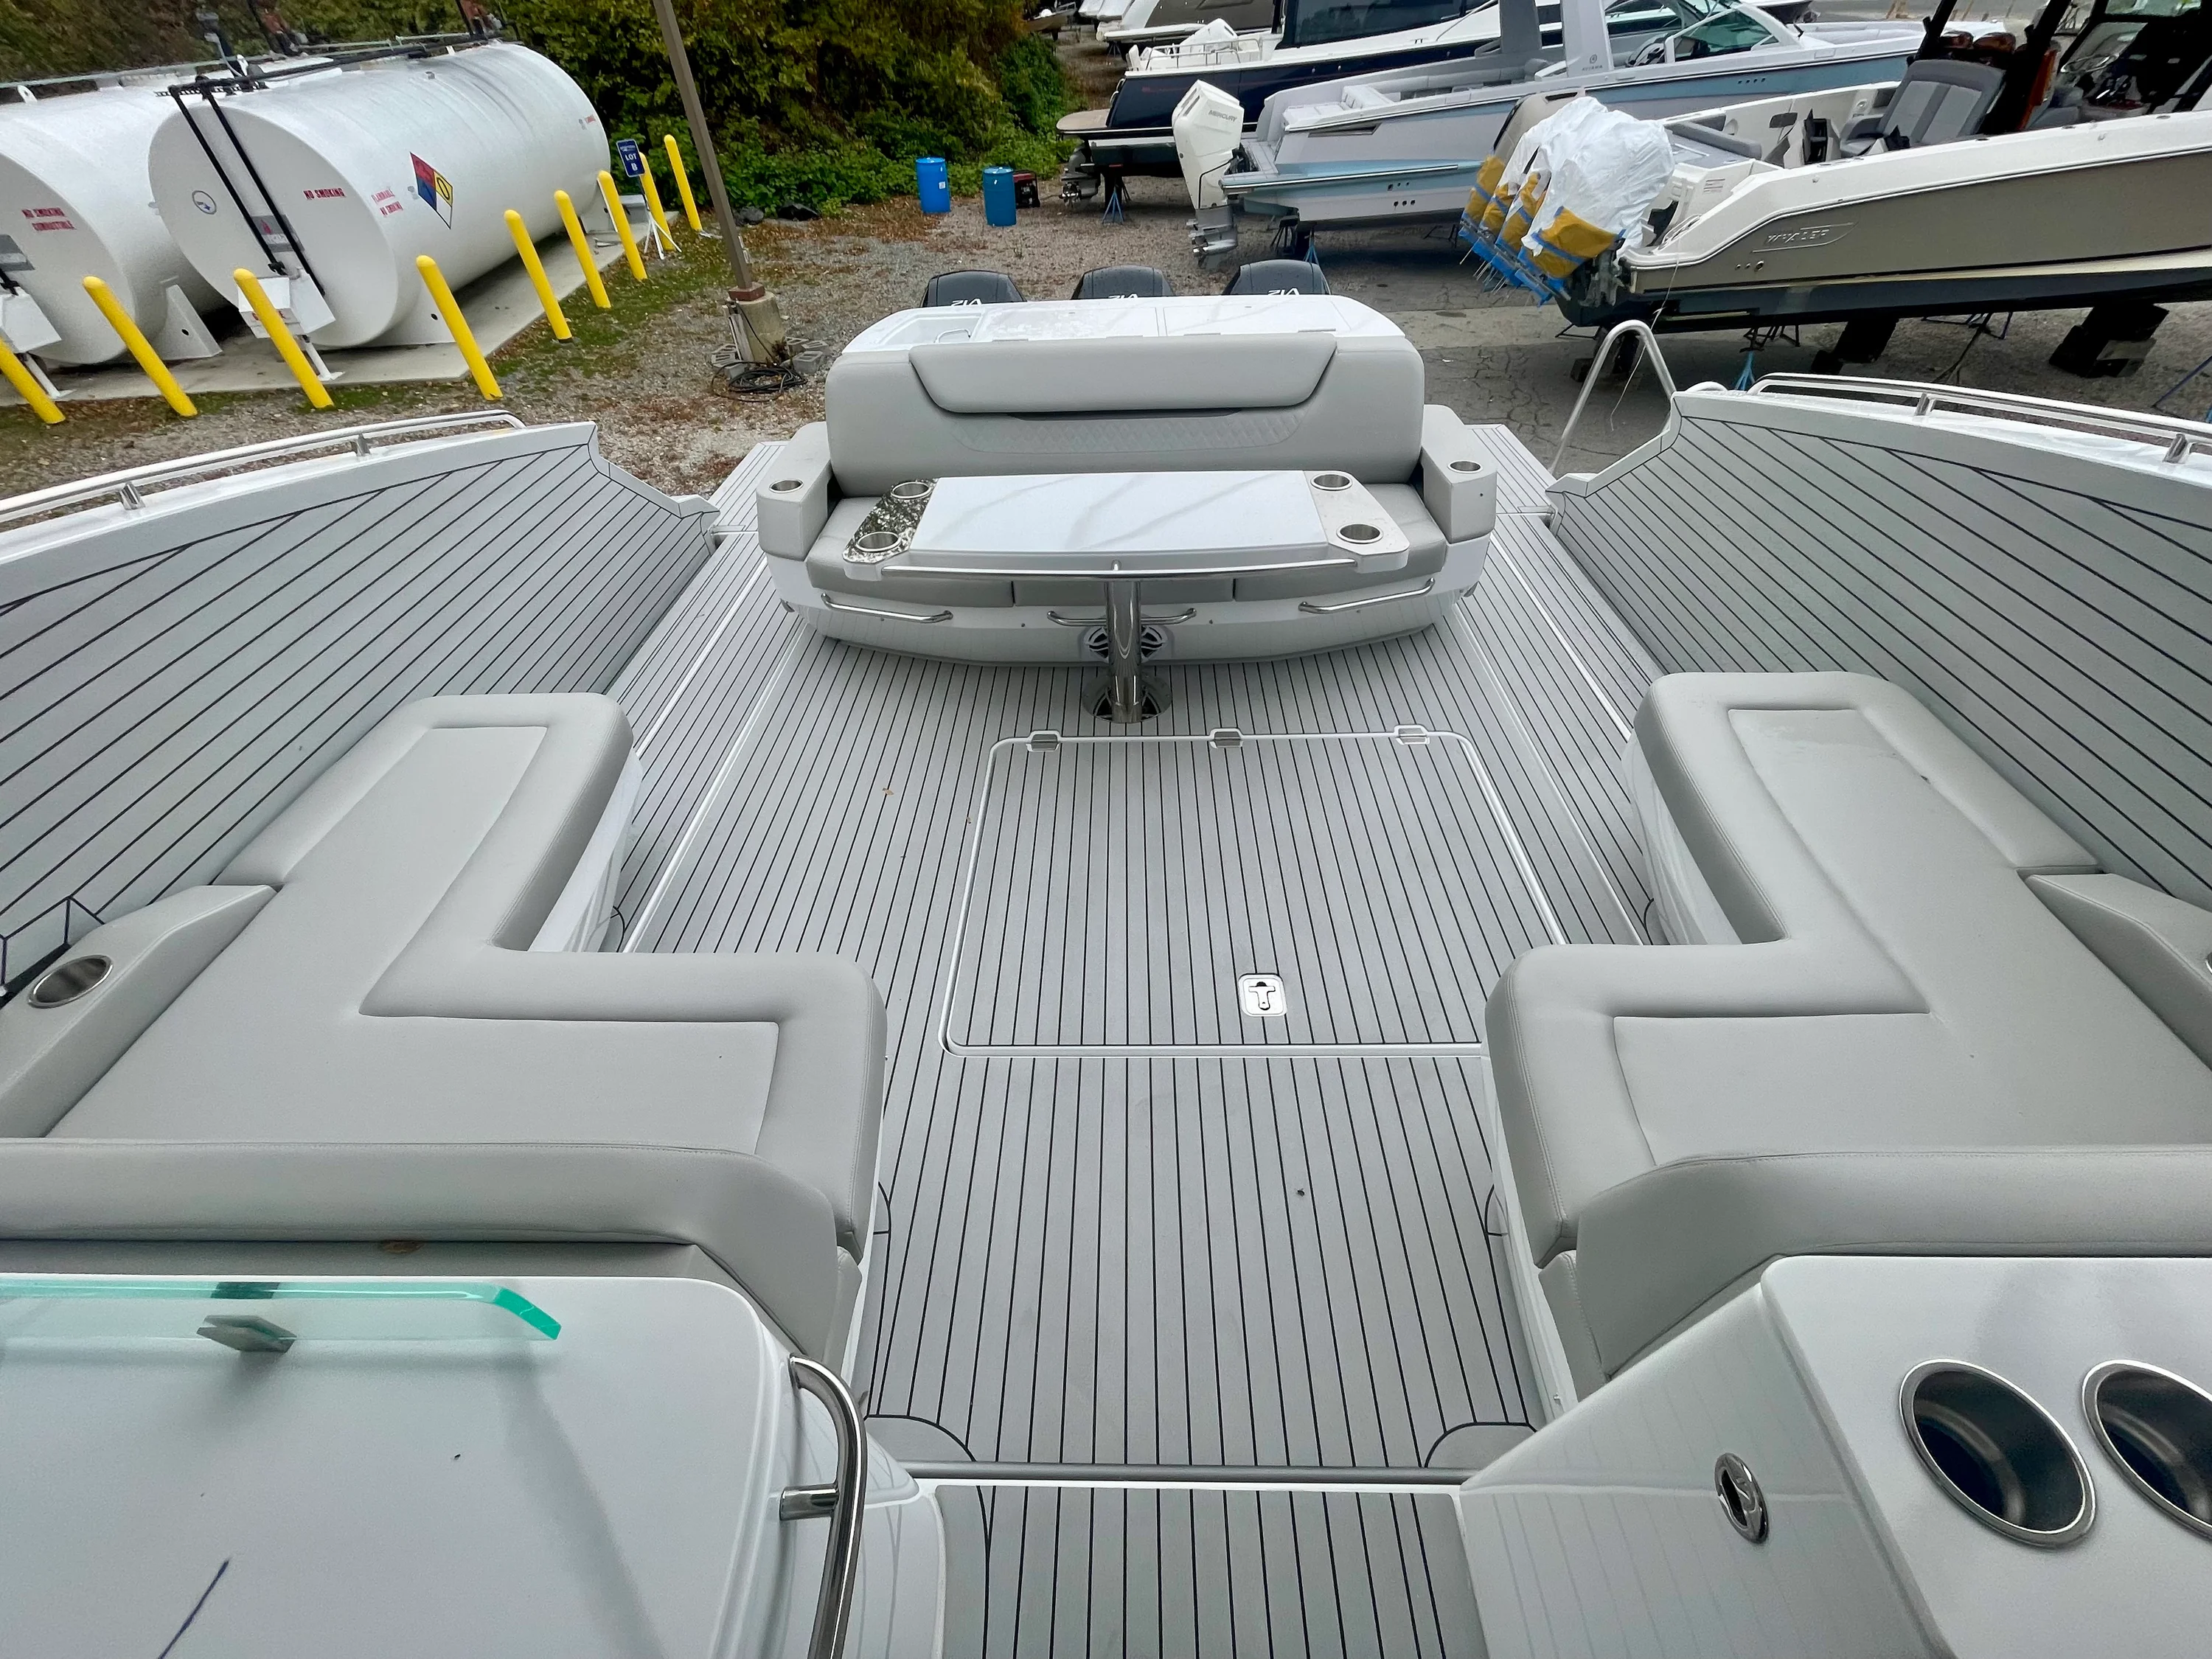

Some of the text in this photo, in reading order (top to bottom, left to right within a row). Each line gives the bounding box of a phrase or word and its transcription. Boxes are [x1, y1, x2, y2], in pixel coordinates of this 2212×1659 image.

[1208, 110, 1237, 122] MERCURY
[625, 153, 637, 161] LOT
[630, 163, 638, 171] B
[303, 187, 346, 200] NO SMOKING
